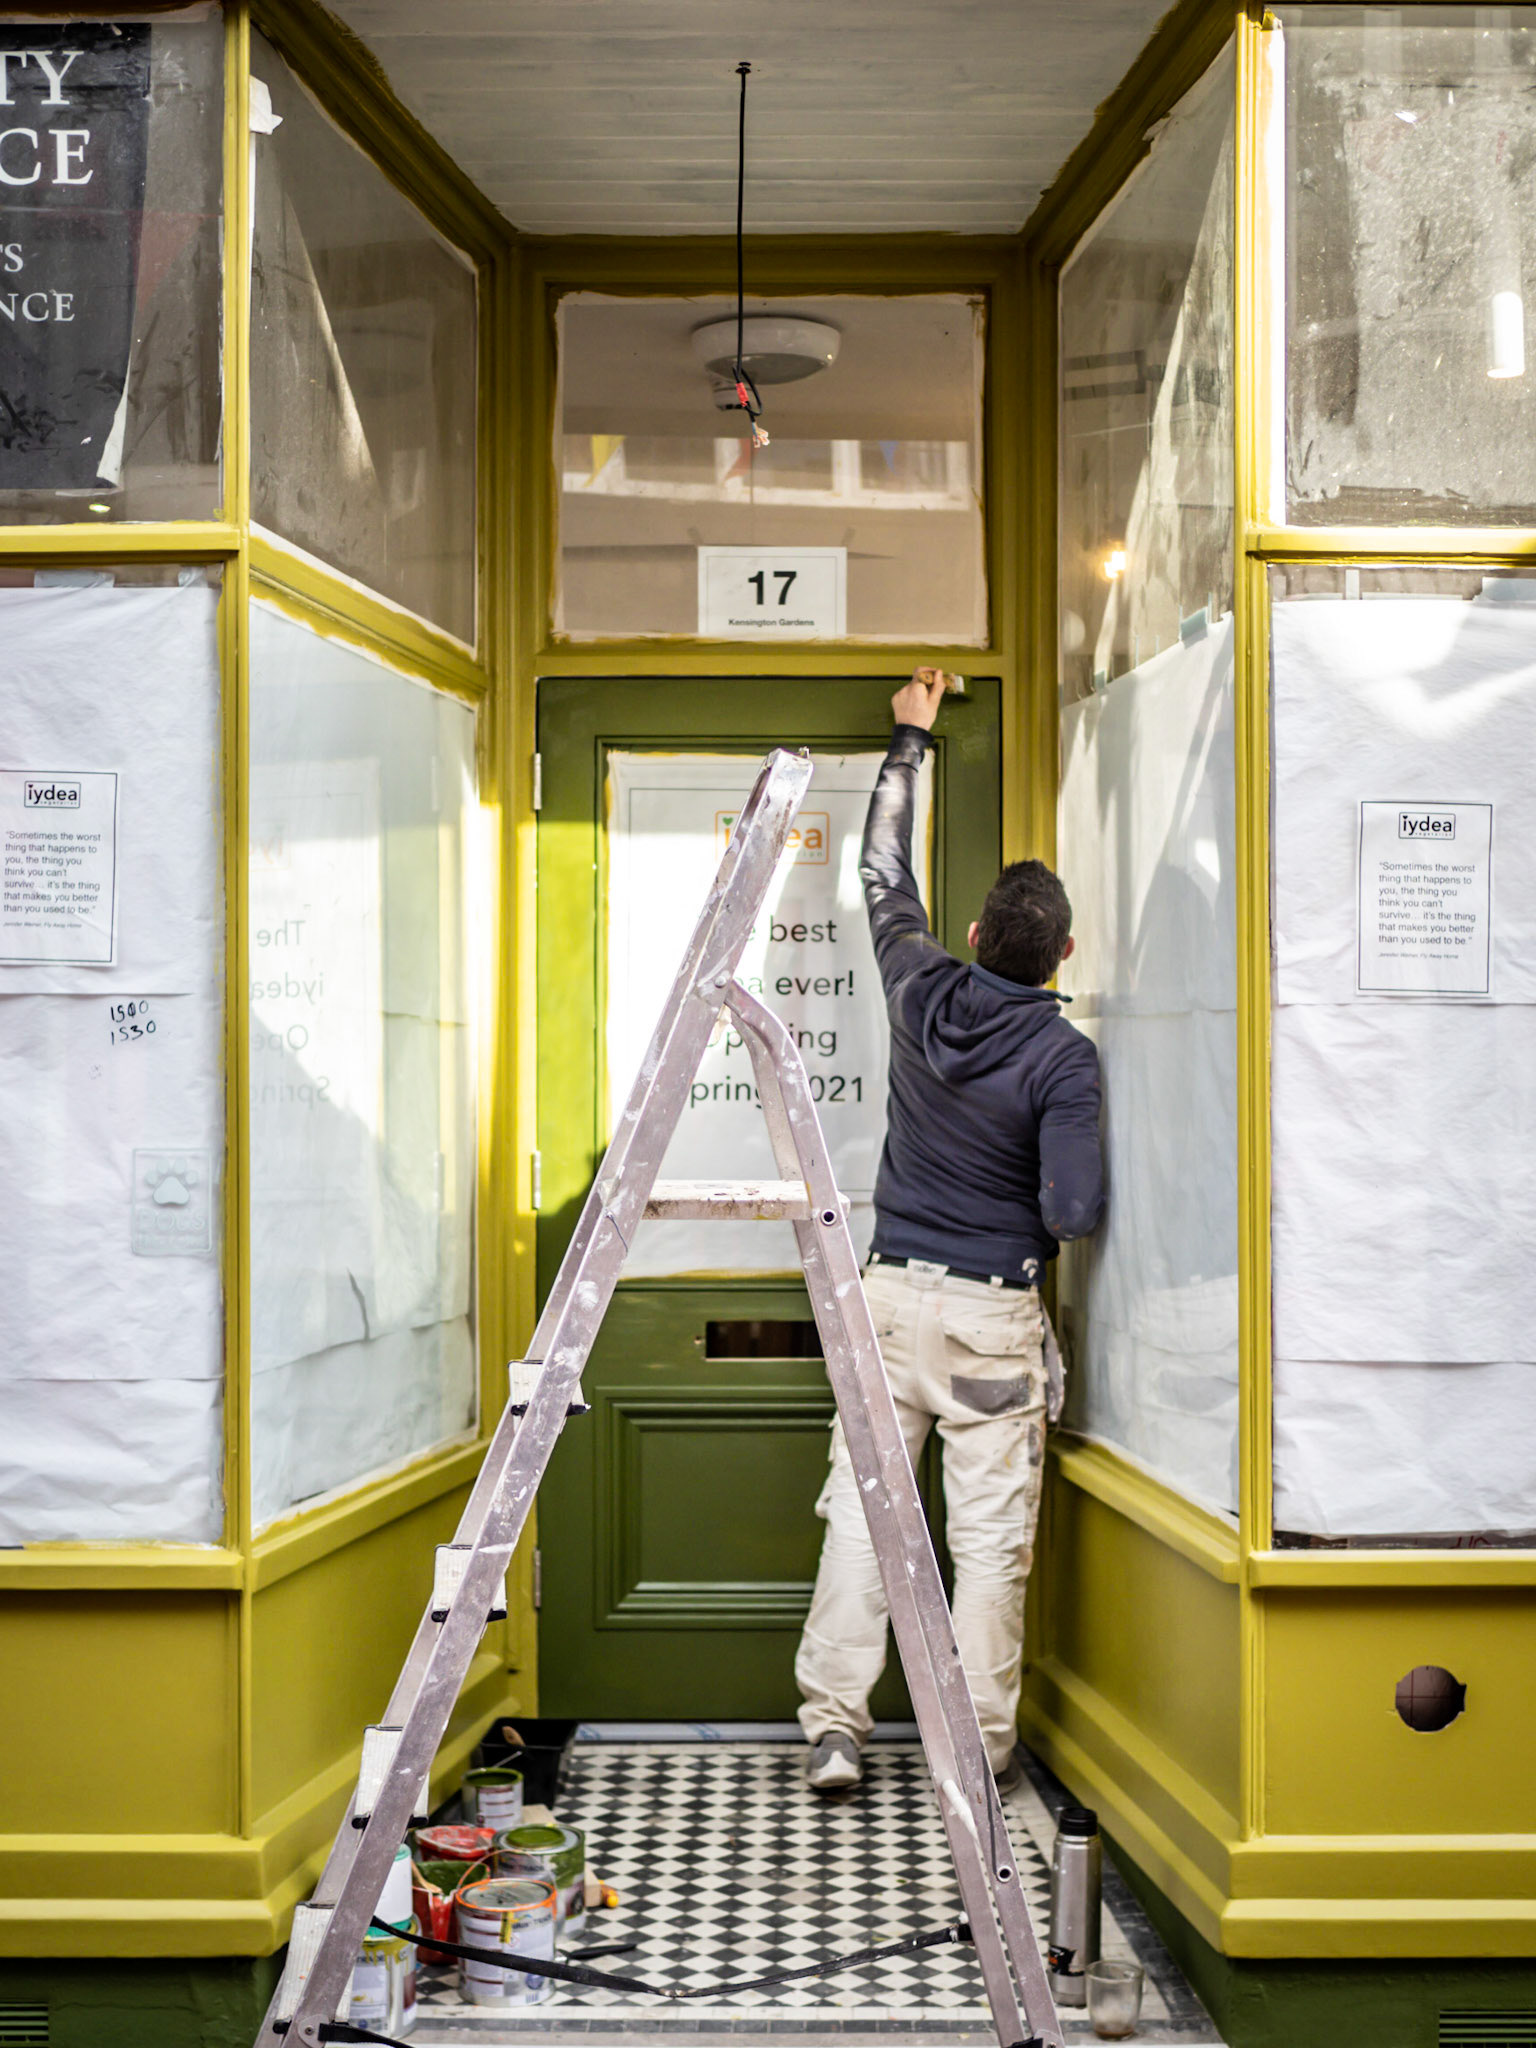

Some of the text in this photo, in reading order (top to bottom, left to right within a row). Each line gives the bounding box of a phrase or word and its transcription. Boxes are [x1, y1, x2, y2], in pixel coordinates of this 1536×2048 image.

[0, 127, 93, 185] CE
[748, 571, 797, 605] 17
[728, 619, 777, 628] Kensington
[28, 784, 78, 804] iydea
[1402, 815, 1452, 836] iydea
[60, 832, 74, 840] the
[76, 833, 101, 841] worst
[5, 843, 26, 853] thing
[29, 844, 45, 852] that
[48, 844, 86, 854] happens
[5, 856, 82, 867] you, the thing you
[4, 867, 25, 876] think
[28, 869, 43, 877] you
[1435, 863, 1449, 872] the
[1379, 874, 1472, 885] thing that happens to
[47, 881, 60, 889] it's
[62, 881, 75, 889] the
[78, 882, 101, 891] thing
[4, 892, 20, 900] that
[55, 894, 70, 902] you
[72, 893, 98, 902] better
[1379, 887, 1457, 897] you, the thing you
[1379, 898, 1443, 908] think you can't
[4, 904, 22, 912] than
[25, 906, 40, 914] you
[43, 905, 65, 913] used
[1423, 911, 1436, 920] it's
[1438, 912, 1451, 920] the
[1454, 912, 1476, 922] thing
[769, 915, 837, 943] best
[1379, 923, 1474, 933] that makes you better
[1379, 935, 1398, 943] than
[1400, 936, 1417, 945] you
[1420, 936, 1441, 944] used
[1444, 936, 1452, 944] to
[775, 970, 854, 996] ever!
[110, 1019, 157, 1046] 1530
